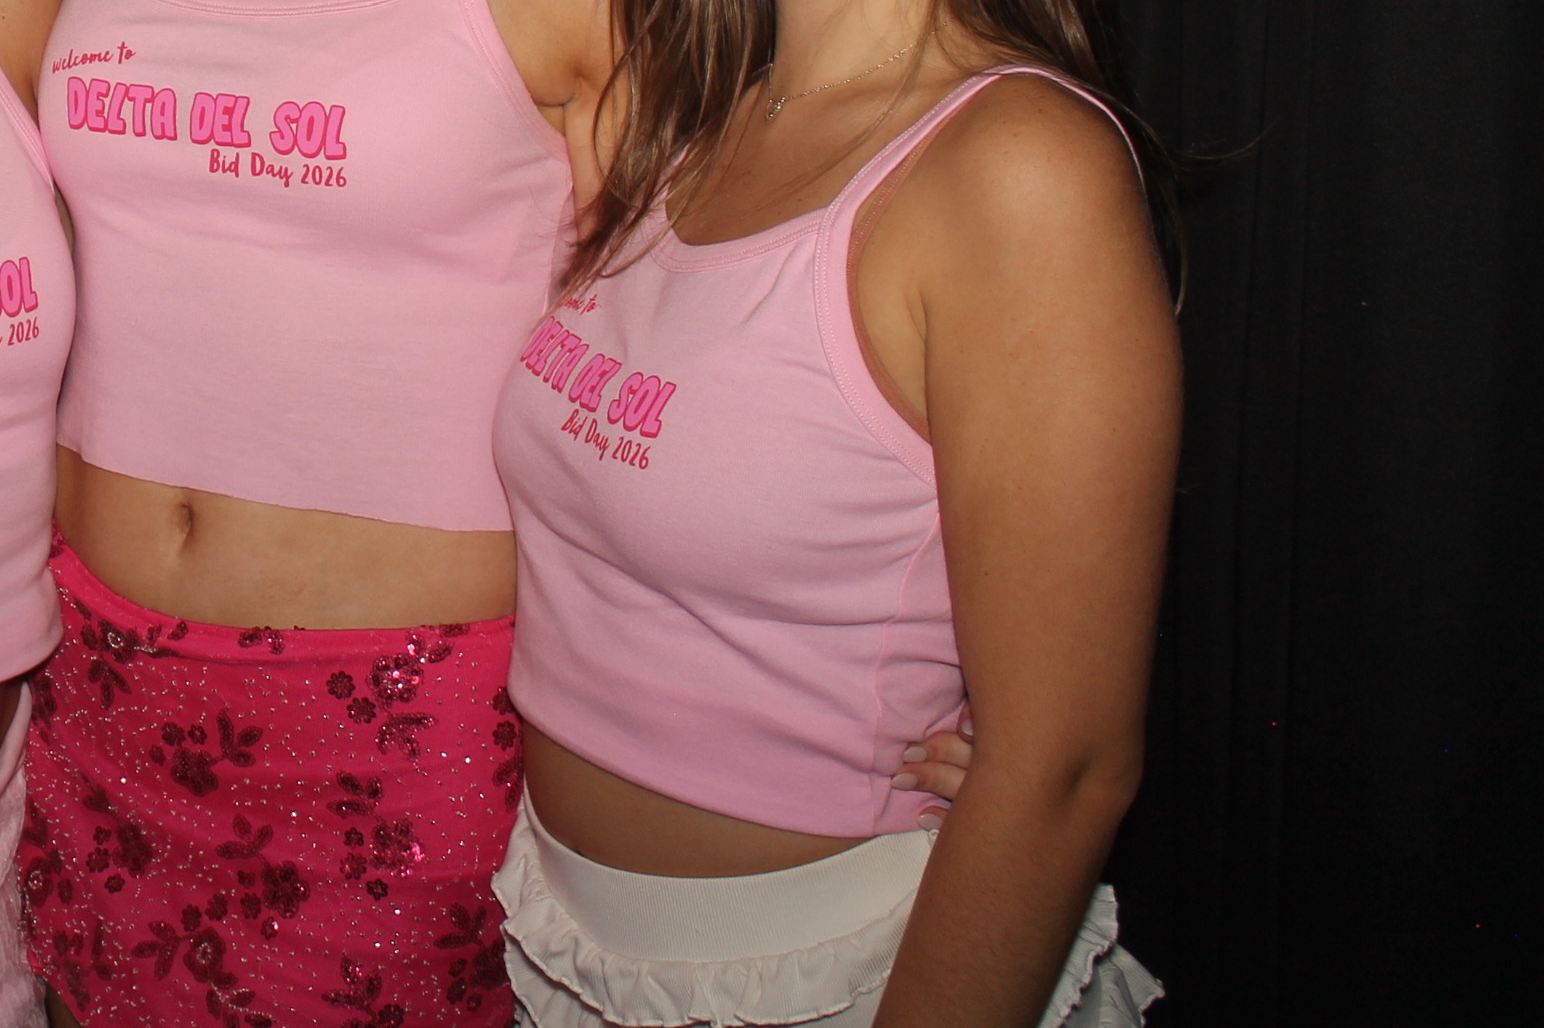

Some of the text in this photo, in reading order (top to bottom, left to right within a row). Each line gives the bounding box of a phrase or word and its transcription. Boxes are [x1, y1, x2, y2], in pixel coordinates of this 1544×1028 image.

[52, 41, 136, 74] welcome to
[67, 76, 347, 160] DELTA DEL SOL
[209, 148, 347, 188] Bid Day 2026
[7, 317, 40, 347] 2026
[568, 353, 623, 413] DEL
[607, 371, 677, 439] SOL
[561, 408, 651, 470] Bid Day 2026
